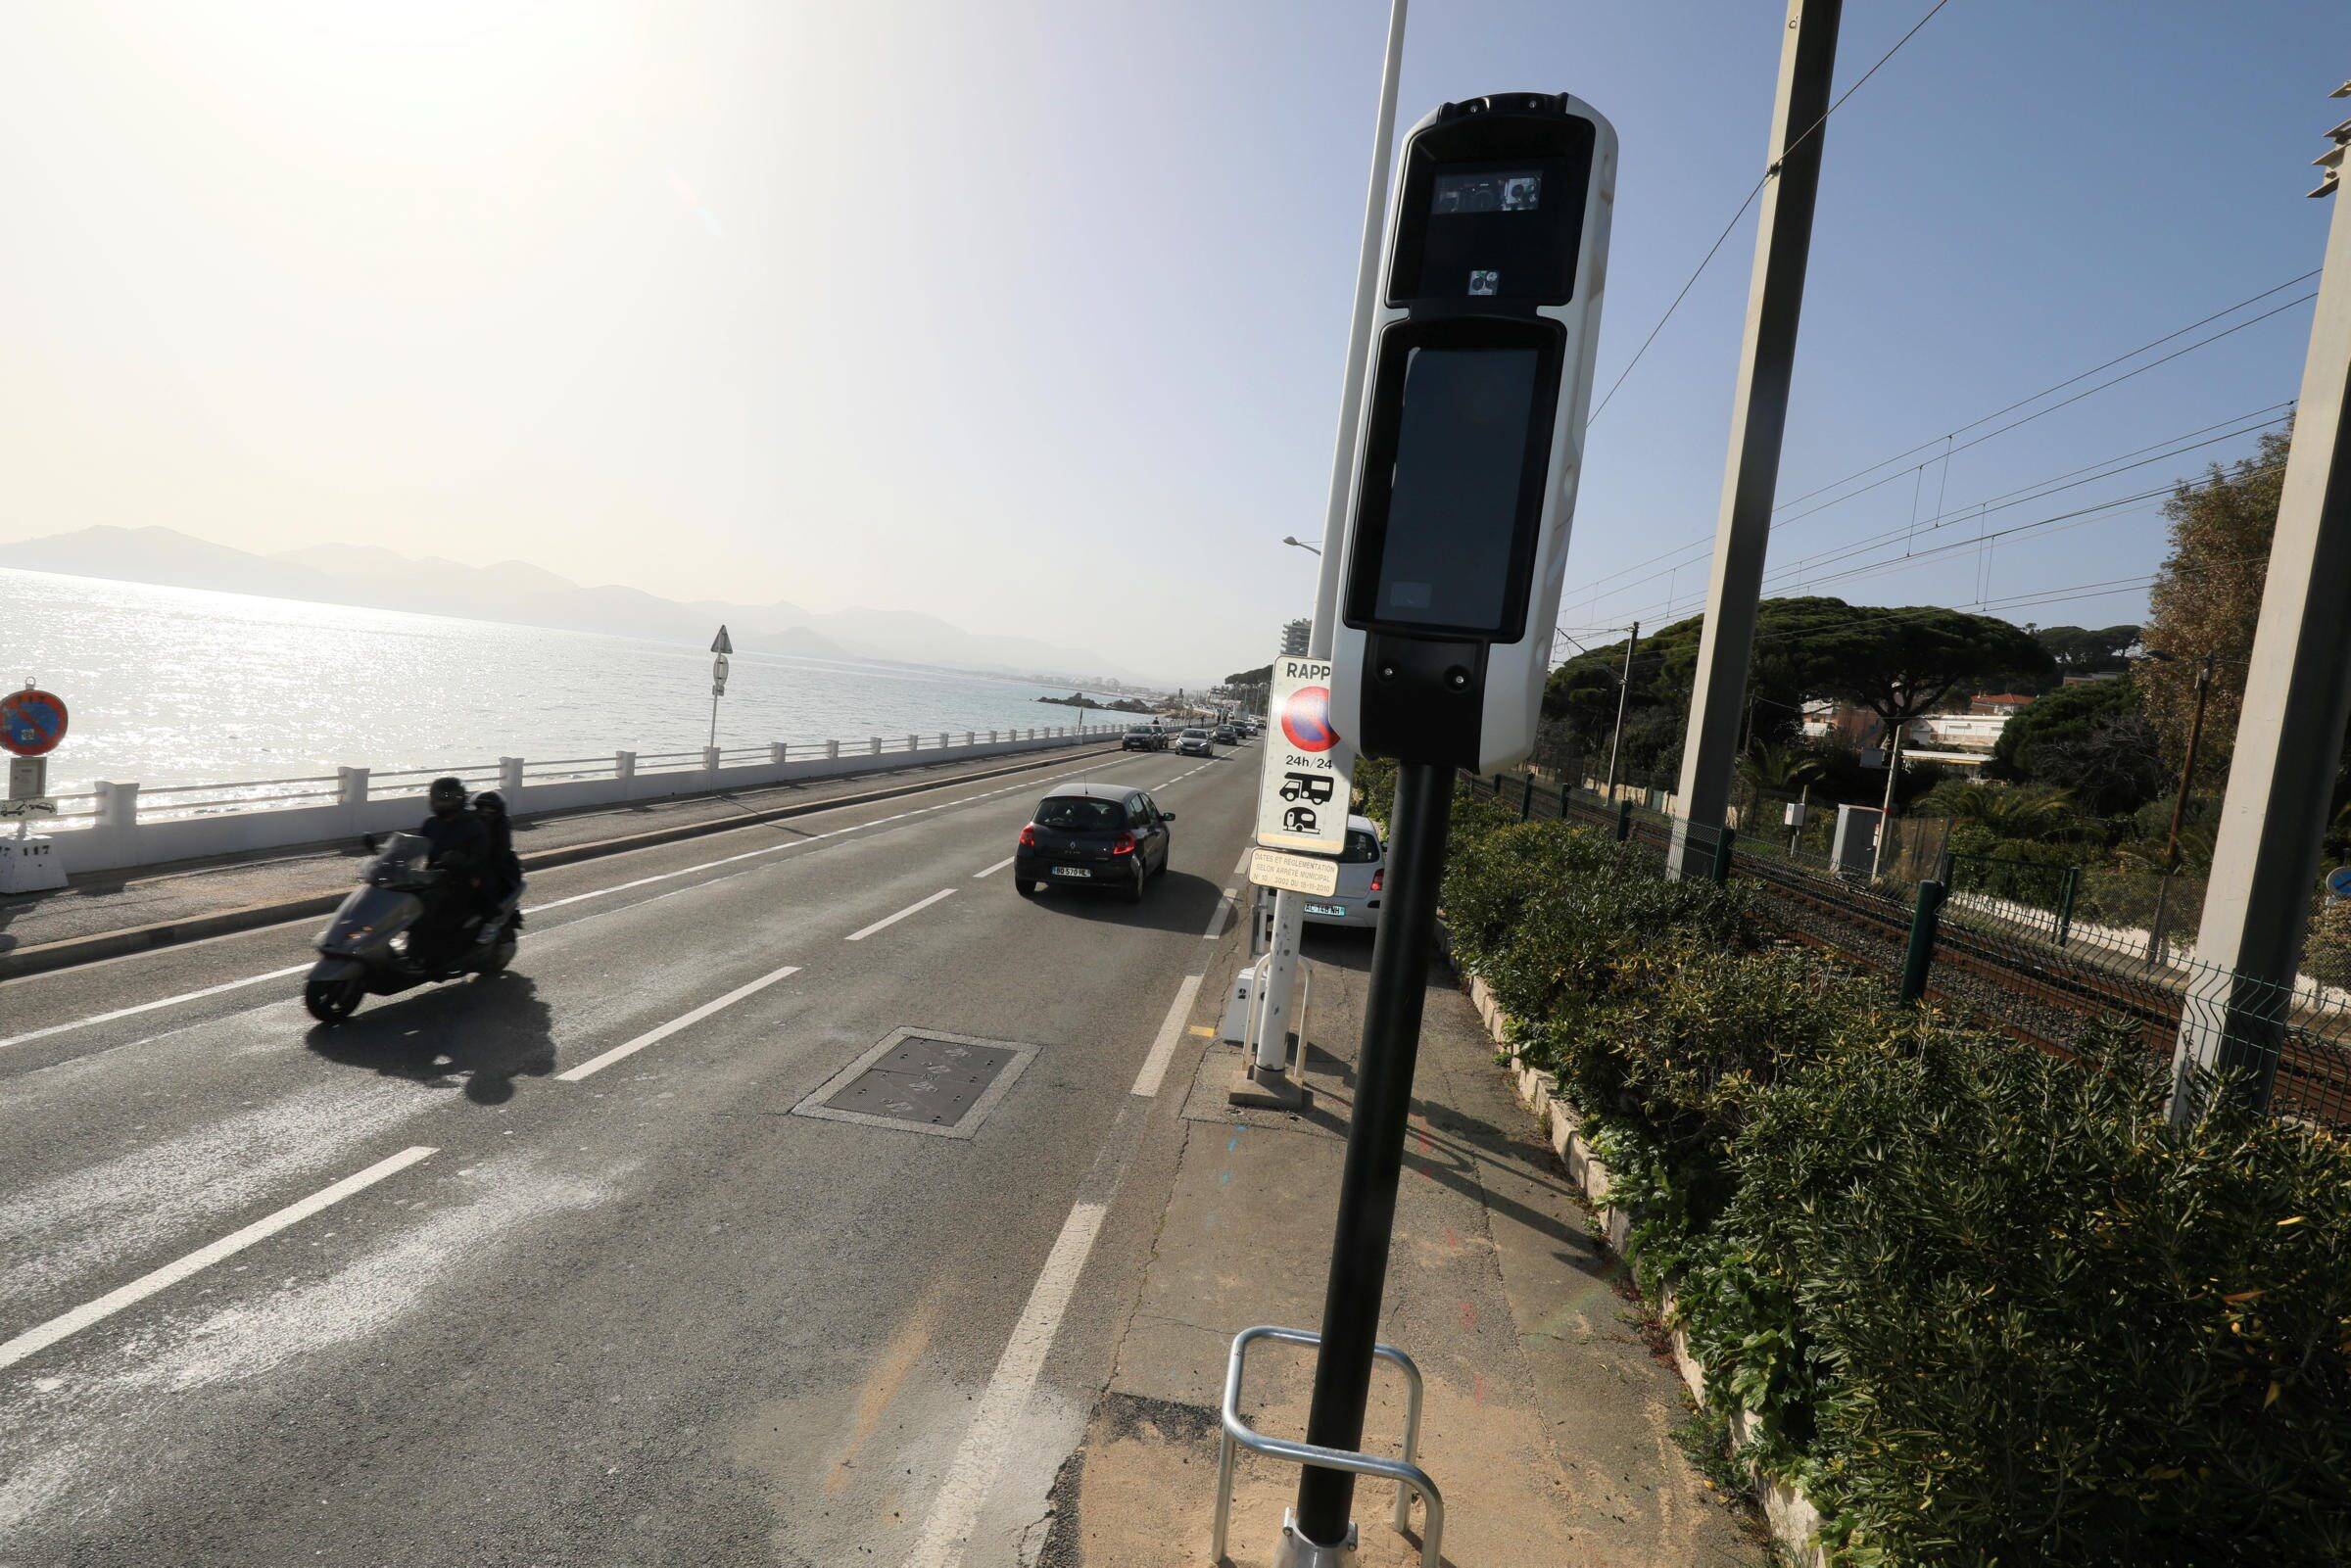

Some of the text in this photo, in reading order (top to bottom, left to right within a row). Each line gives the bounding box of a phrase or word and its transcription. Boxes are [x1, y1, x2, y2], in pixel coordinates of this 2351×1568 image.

[1286, 662, 1330, 681] RAPP
[1285, 754, 1332, 769] 24h/24
[1256, 863, 1275, 873] SELON
[1300, 871, 1330, 882] MUNICIPAL
